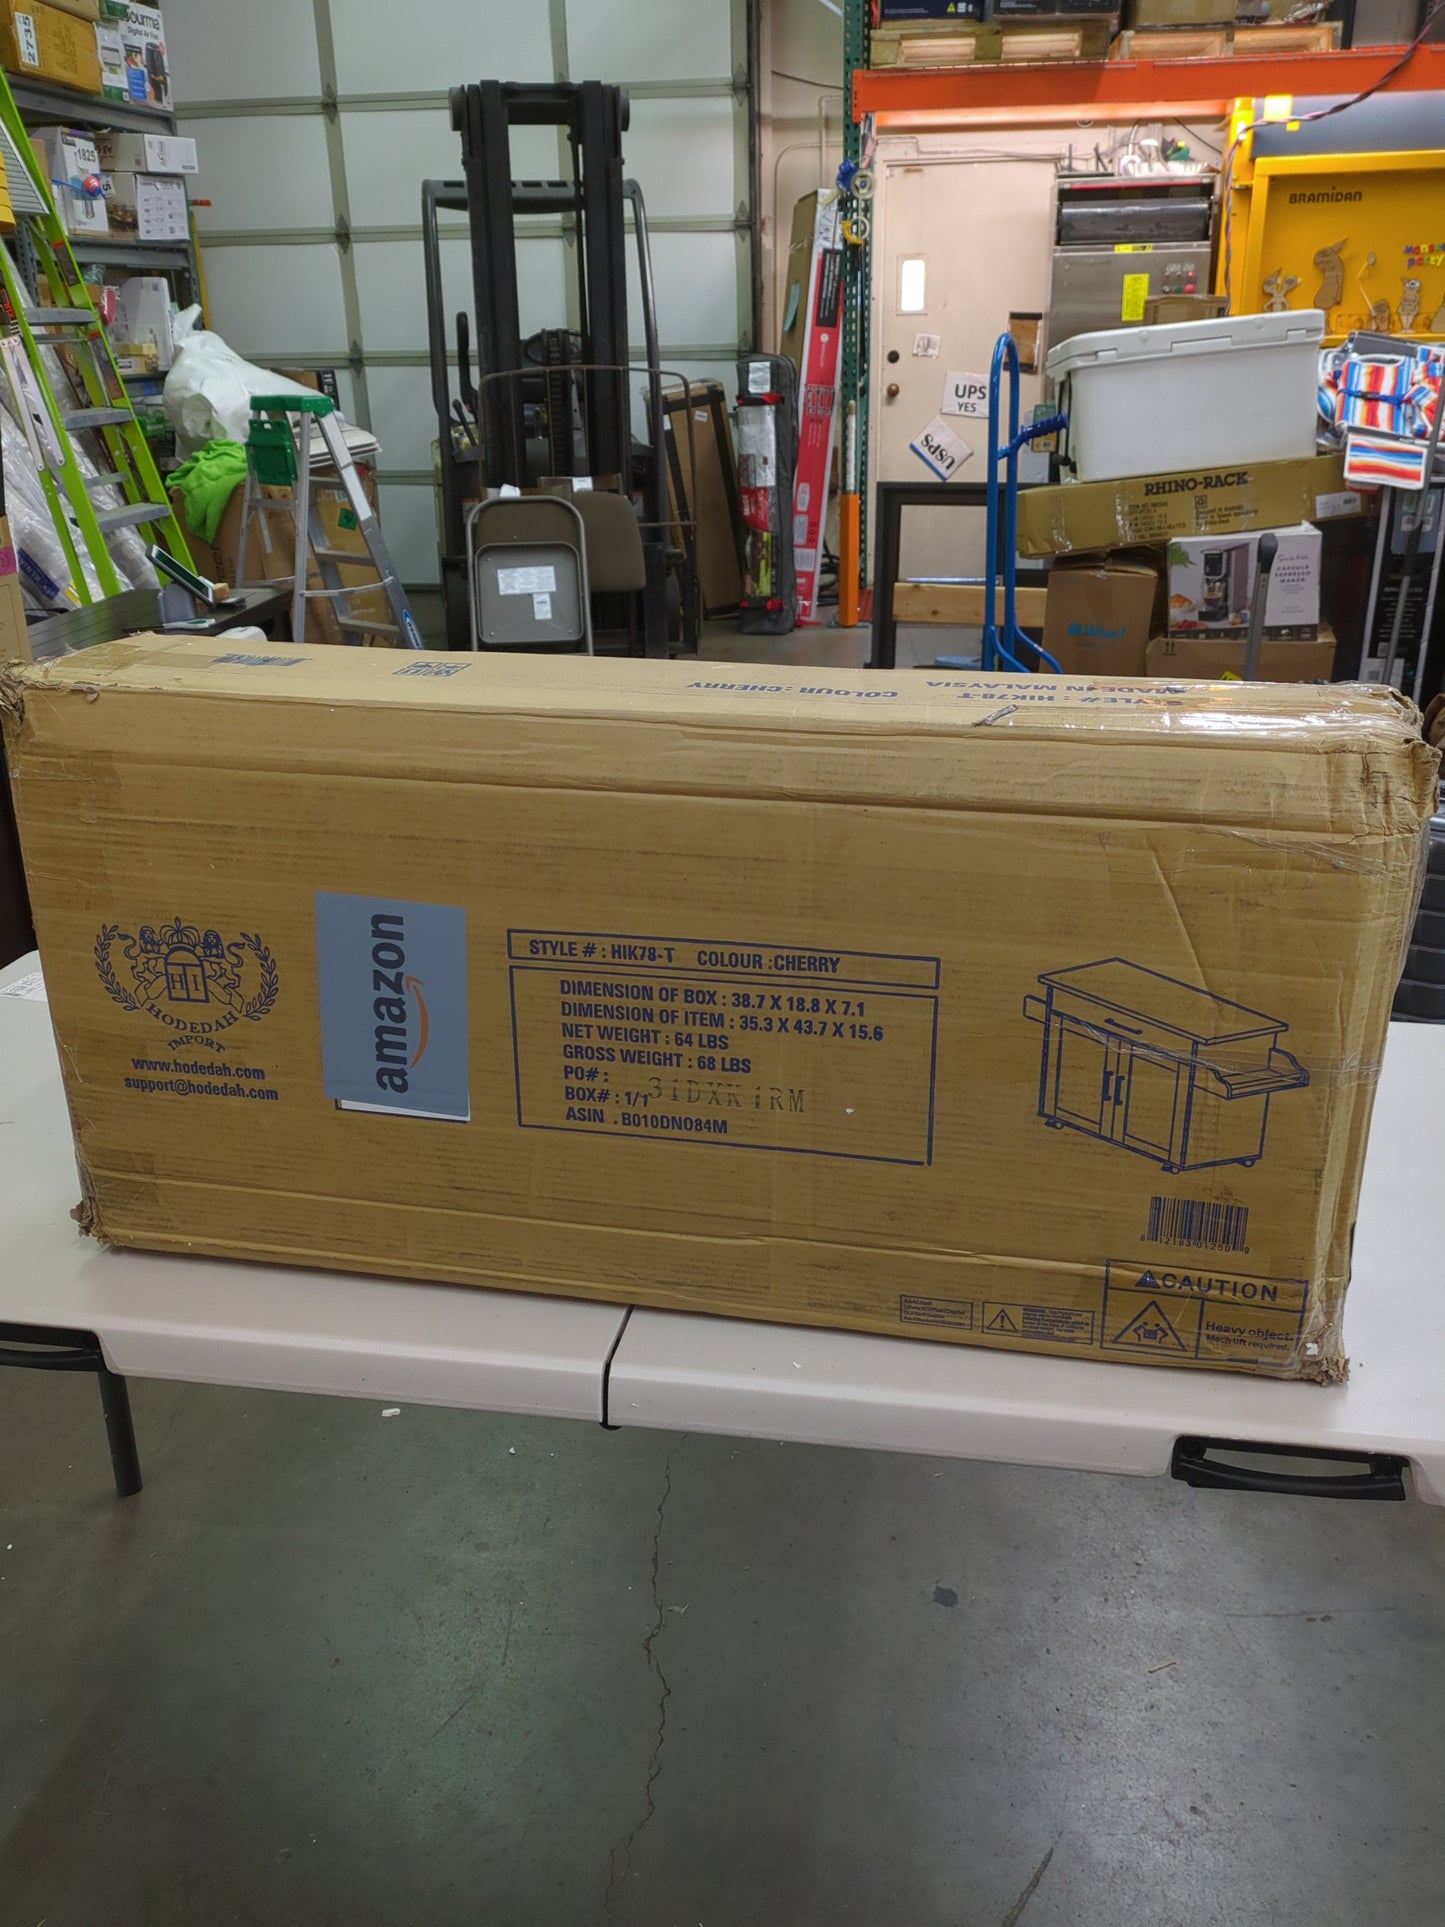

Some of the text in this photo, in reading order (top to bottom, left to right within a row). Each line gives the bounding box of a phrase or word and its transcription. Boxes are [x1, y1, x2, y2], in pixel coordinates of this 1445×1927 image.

[22, 16, 37, 63] 2735
[77, 147, 96, 163] 1825
[954, 384, 987, 400] UPS
[957, 401, 977, 413] YES
[920, 433, 956, 470] USPS
[1144, 471, 1250, 497] RHINO-RACK
[800, 687, 899, 698] COLOUR
[926, 681, 1186, 695] MADE IN MALAYSIA
[957, 692, 1055, 702] HIK78-T
[529, 940, 577, 958] STYLE
[611, 944, 675, 963] HIK78-T
[697, 950, 763, 969] COLOUR
[371, 913, 409, 1094] amazon
[560, 979, 654, 1001] DIMENSION
[658, 987, 679, 1003] OF
[684, 989, 718, 1006] BOX
[731, 992, 766, 1009] 38.7
[770, 995, 782, 1011] X
[787, 996, 820, 1013] 18.8
[825, 998, 837, 1015] X
[842, 1000, 865, 1018] 7.1
[146, 1003, 239, 1034] HODEDAH
[561, 1001, 655, 1023] DIMENSION
[659, 1009, 679, 1025] OF
[684, 1010, 725, 1028] ITEM
[739, 1015, 773, 1032] 35.3
[777, 1017, 790, 1034] X
[793, 1020, 828, 1036] 43.7
[832, 1022, 845, 1039] X
[849, 1024, 884, 1041] 15.6
[167, 1035, 226, 1055] IMPORT
[562, 1023, 593, 1039] NET
[597, 1026, 661, 1045] WEIGHT
[675, 1032, 694, 1048] 64
[698, 1033, 730, 1050] LBS
[131, 1058, 265, 1080] www.hodedah.com
[563, 1044, 616, 1062] GROSS
[620, 1048, 684, 1068] WEIGHT
[697, 1056, 716, 1071] 68
[721, 1056, 752, 1073] LBS
[563, 1065, 600, 1081] PO#
[124, 1076, 279, 1101] support@hodedah.com
[564, 1086, 611, 1103] BOX#
[624, 1091, 649, 1108] 1/1
[565, 1106, 605, 1123] ASIN
[1161, 1272, 1279, 1302] CAUTION
[1206, 1321, 1294, 1341] Heavy object.
[1206, 1334, 1231, 1345] Mech
